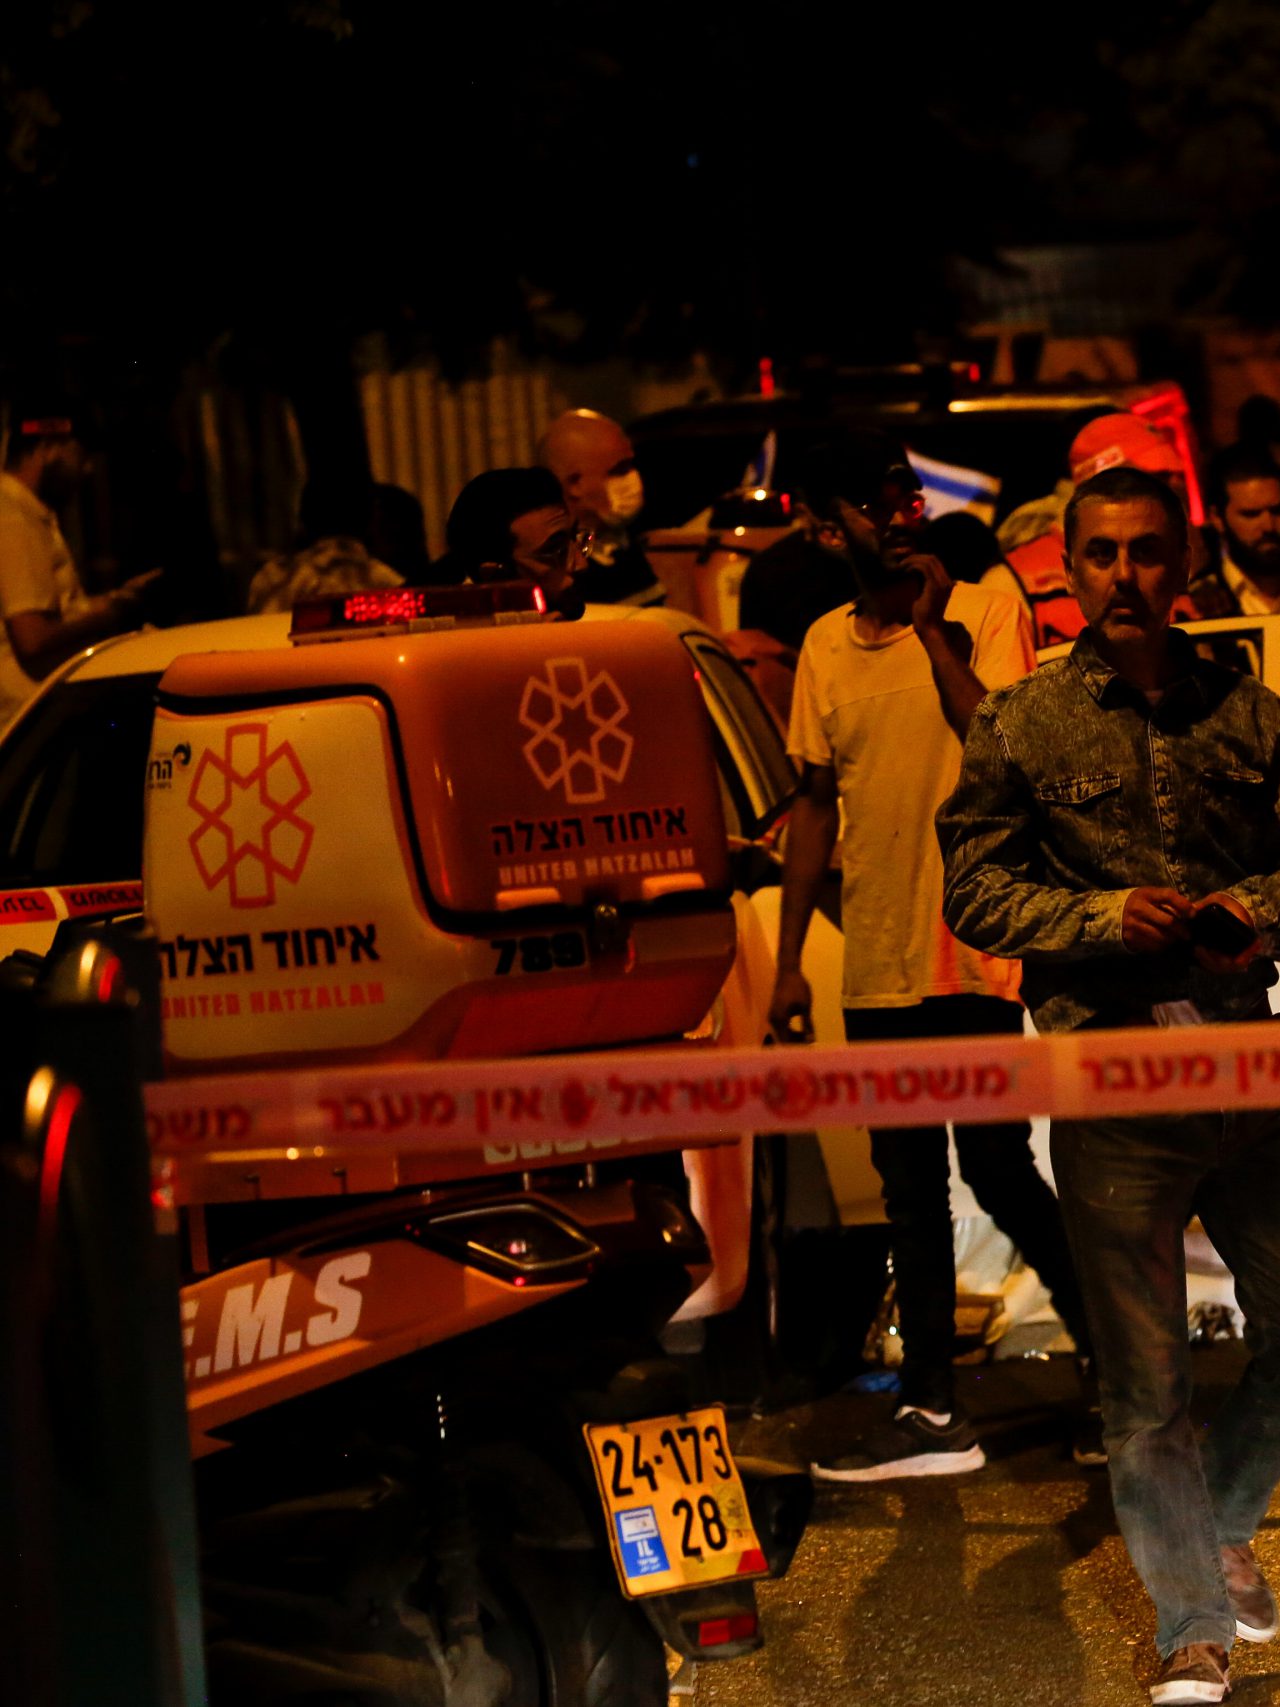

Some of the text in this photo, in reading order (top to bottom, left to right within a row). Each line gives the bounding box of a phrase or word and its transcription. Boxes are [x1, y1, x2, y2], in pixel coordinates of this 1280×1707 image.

[491, 806, 688, 856] איחוד הצלה
[499, 847, 695, 887] UNITED HATZALAH
[261, 923, 380, 968] איחוד
[491, 933, 585, 976] 789
[250, 981, 384, 1014] HATZALAH
[1079, 1054, 1216, 1091] מעבר
[318, 1065, 1008, 1132] משטרת ישראל אין מעבר
[673, 1495, 728, 1558] 28
